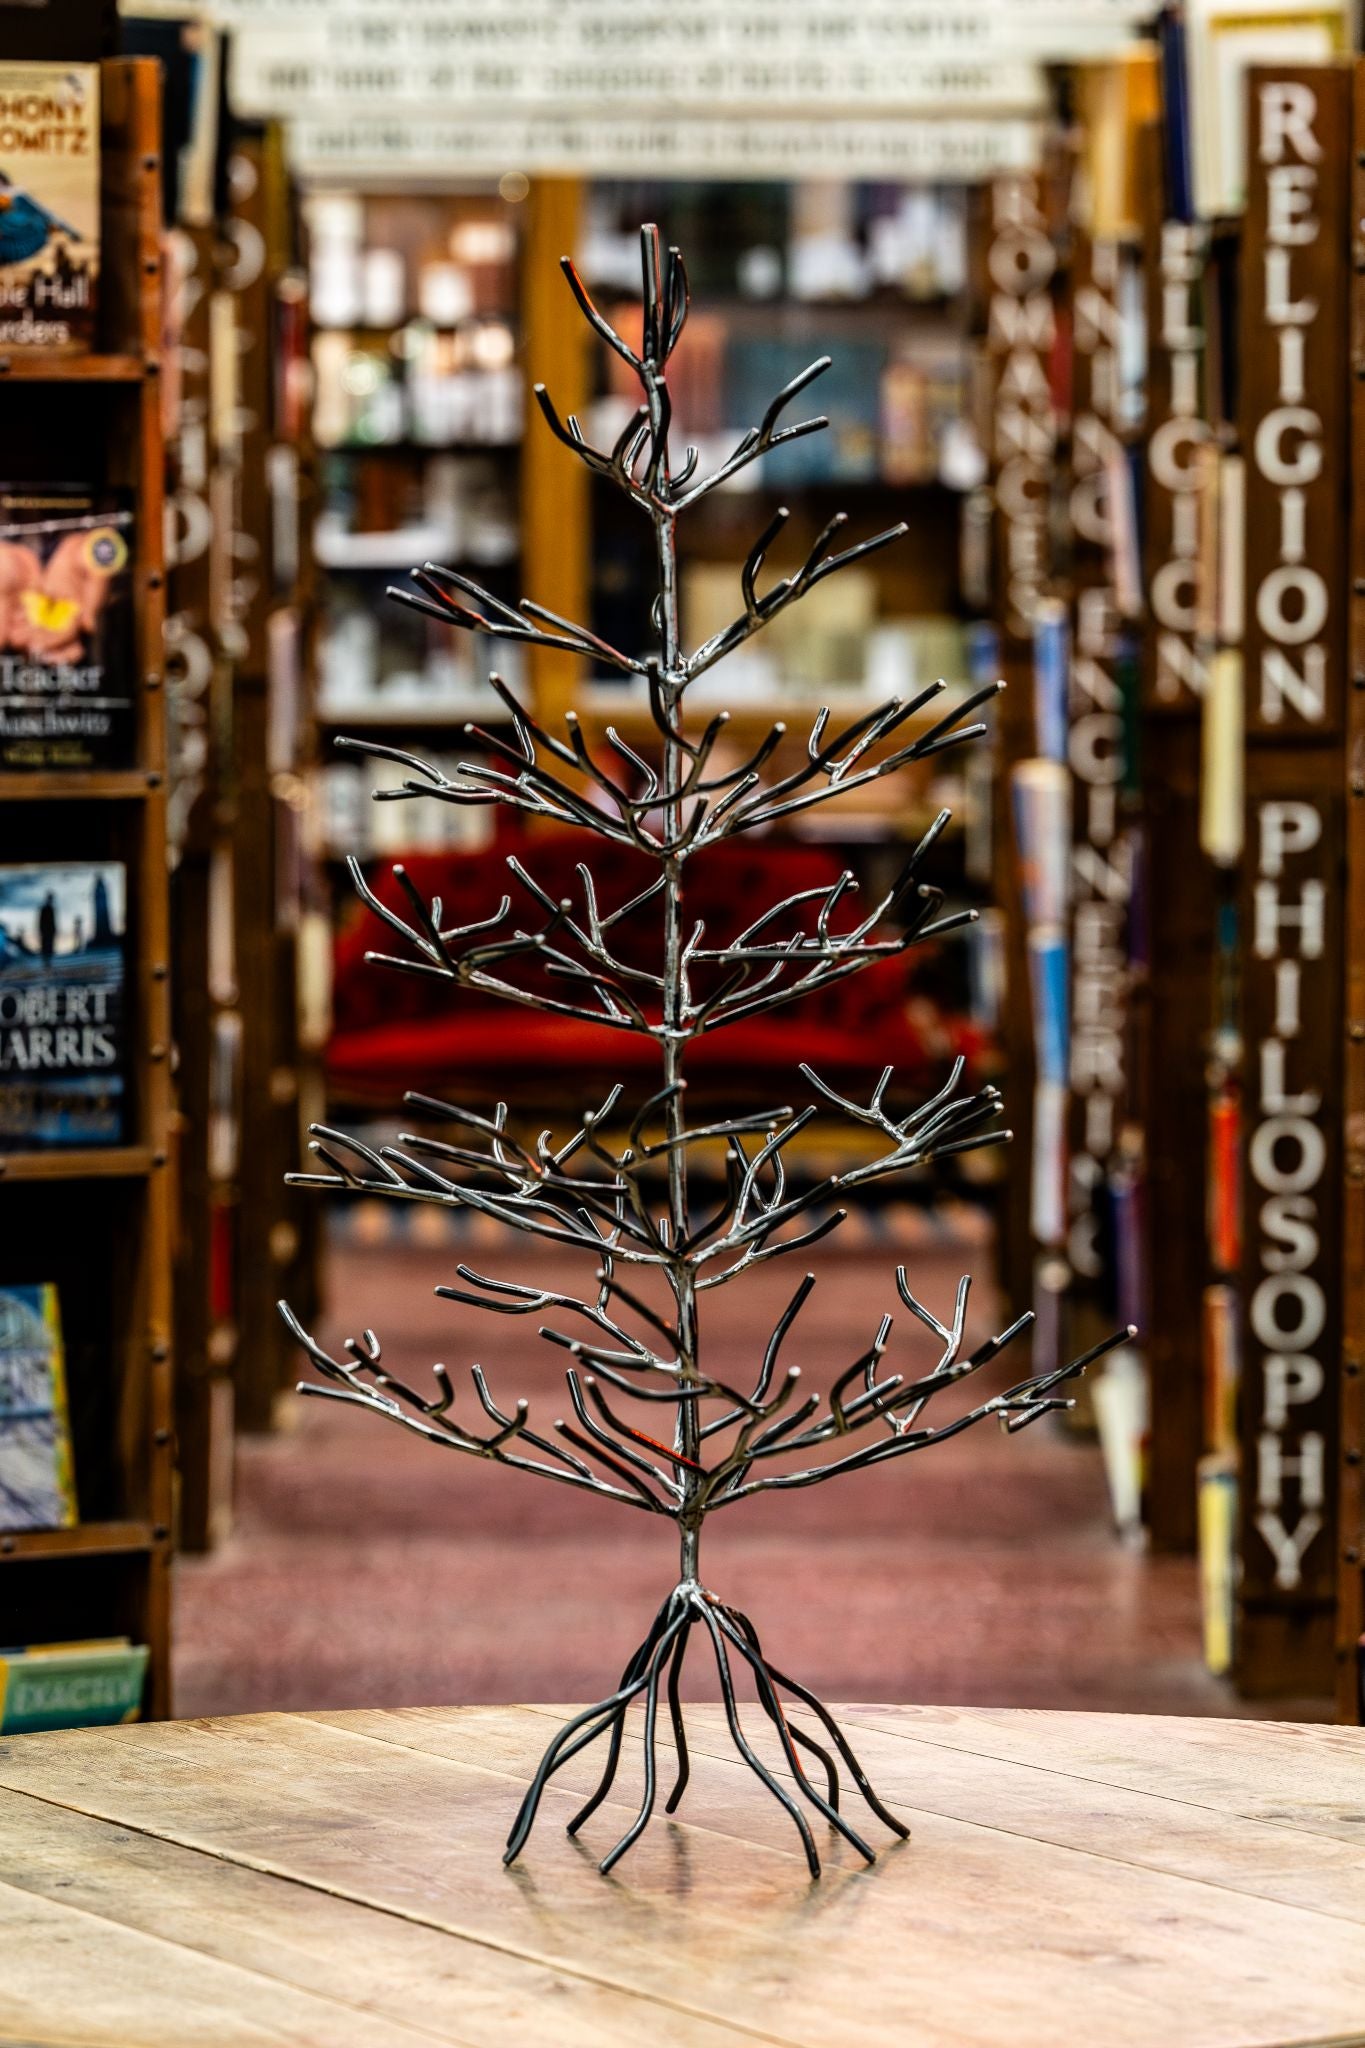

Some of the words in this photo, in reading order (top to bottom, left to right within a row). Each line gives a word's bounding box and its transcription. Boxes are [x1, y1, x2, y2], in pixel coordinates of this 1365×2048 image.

[33, 273, 90, 309] Hall
[1255, 80, 1328, 725] RELIGION
[1150, 222, 1214, 697] ELIGION
[0, 984, 118, 1027] OBERT
[0, 1025, 116, 1070] ARRIS
[1250, 802, 1327, 1590] PHILOSOPHY
